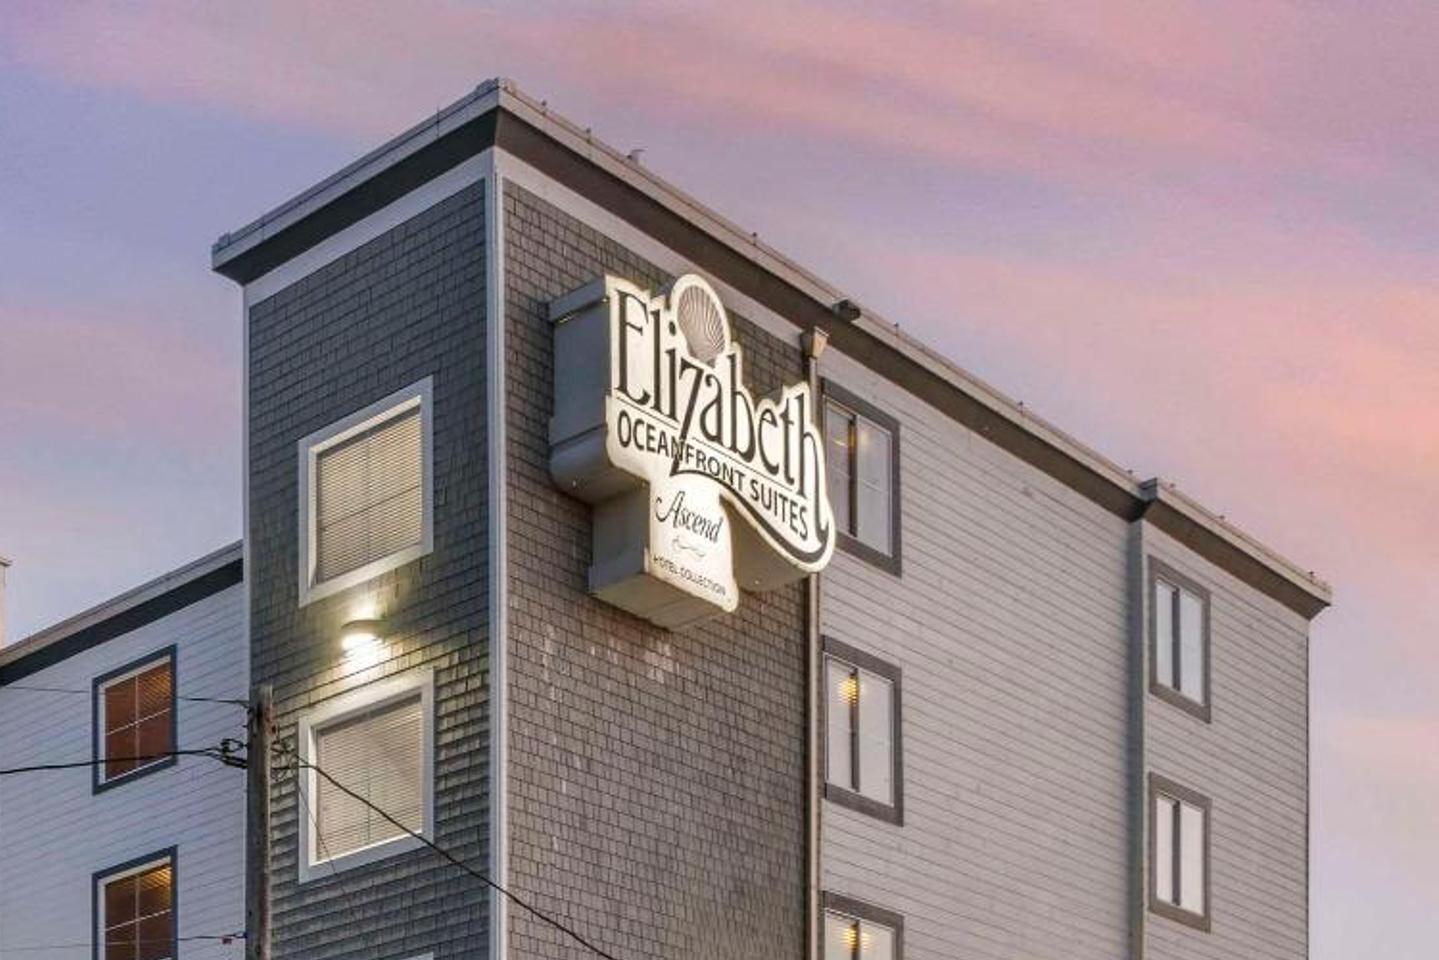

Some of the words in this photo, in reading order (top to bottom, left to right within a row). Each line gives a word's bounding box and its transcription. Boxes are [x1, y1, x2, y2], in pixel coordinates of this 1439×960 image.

[614, 289, 829, 545] Elizabeth
[617, 410, 745, 491] OCEANFRONT
[749, 479, 809, 542] SUITES
[655, 490, 724, 543] Ascend
[653, 554, 678, 575] HOTEL
